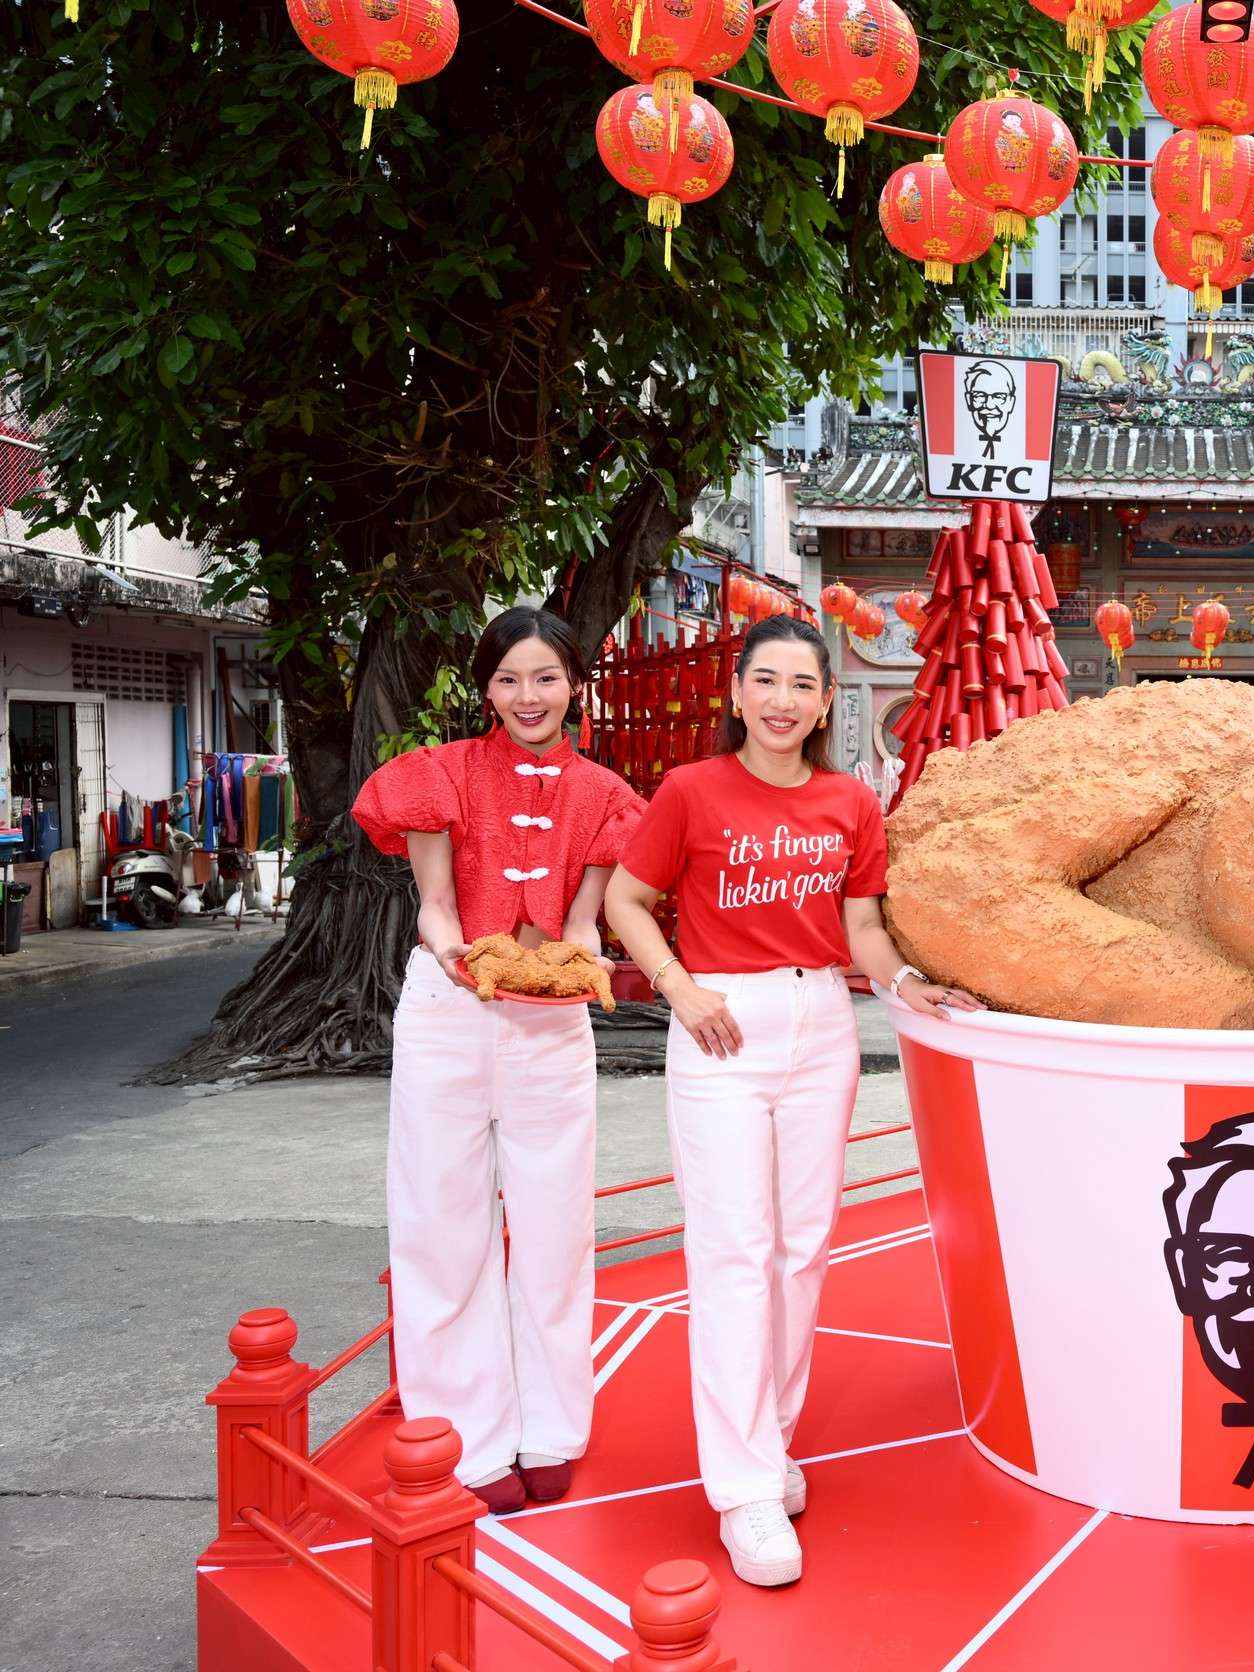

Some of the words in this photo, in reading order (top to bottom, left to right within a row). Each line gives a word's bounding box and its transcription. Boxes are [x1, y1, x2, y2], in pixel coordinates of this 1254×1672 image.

[946, 463, 1033, 494] KFC
[770, 825, 844, 866] finger
[718, 866, 792, 910] lickin'
